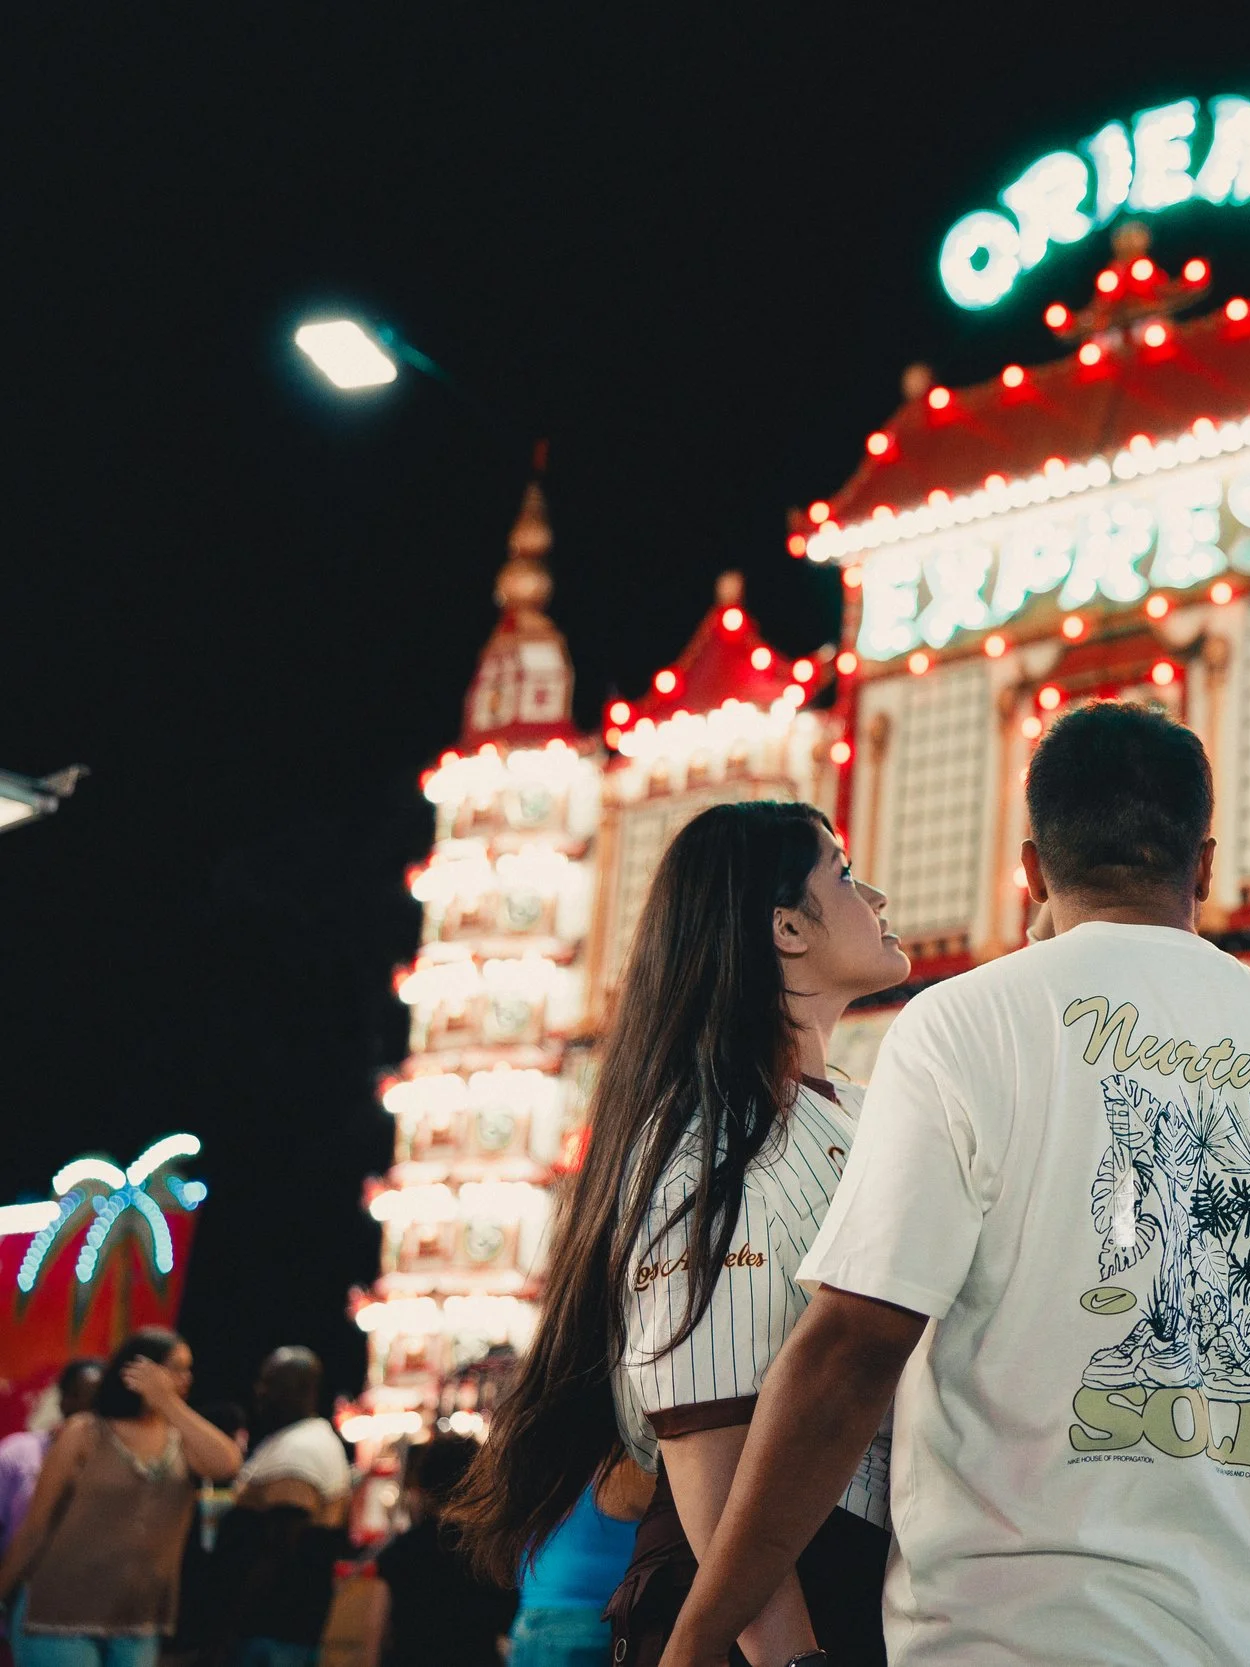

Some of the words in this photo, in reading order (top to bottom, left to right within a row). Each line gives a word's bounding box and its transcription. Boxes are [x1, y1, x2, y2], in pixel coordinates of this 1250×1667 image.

[661, 1243, 768, 1277] Aeles
[1081, 1455, 1102, 1463] HOUSE
[1103, 1454, 1112, 1462] OF
[1113, 1455, 1154, 1464] PROPAGATION
